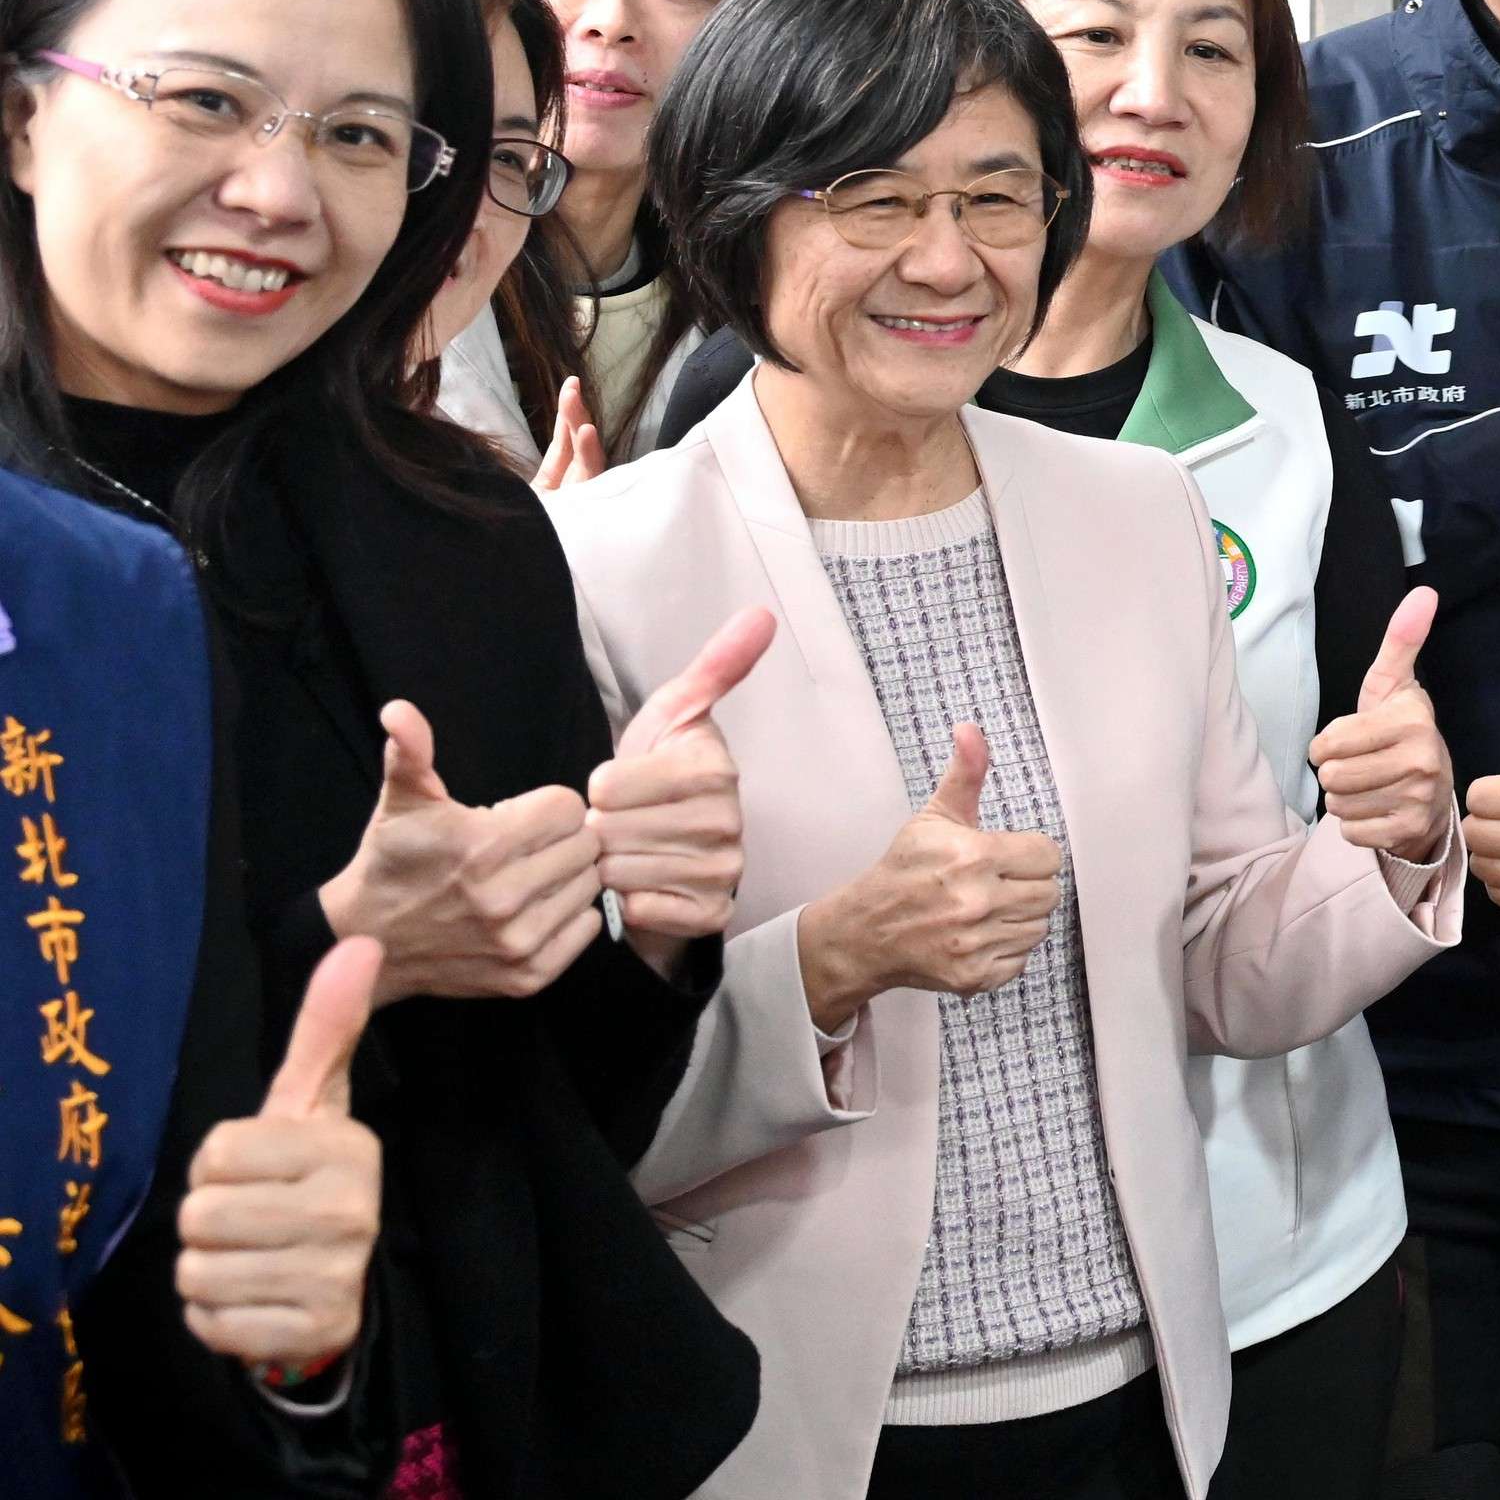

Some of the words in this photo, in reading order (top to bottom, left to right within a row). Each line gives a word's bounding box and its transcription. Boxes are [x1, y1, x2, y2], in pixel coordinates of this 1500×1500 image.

[1343, 385, 1467, 410] 新北市政府
